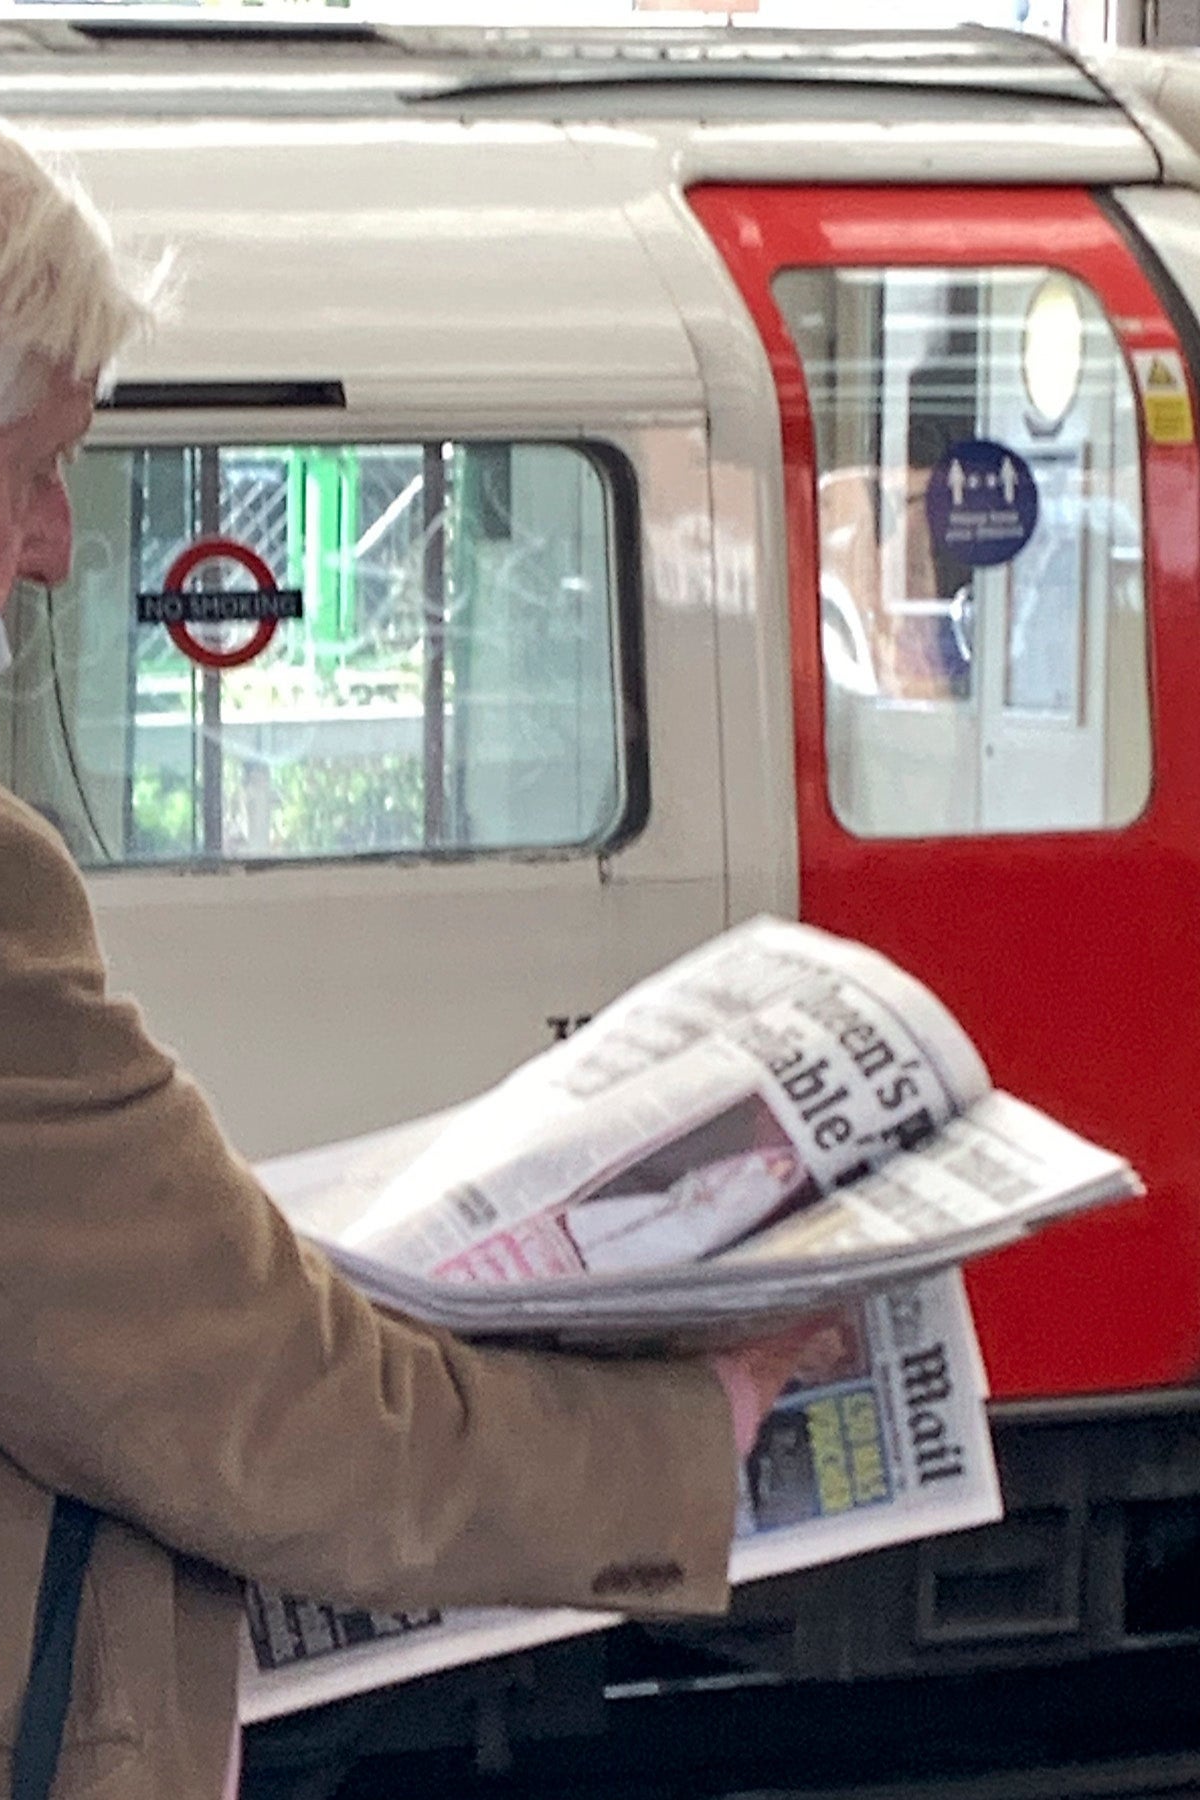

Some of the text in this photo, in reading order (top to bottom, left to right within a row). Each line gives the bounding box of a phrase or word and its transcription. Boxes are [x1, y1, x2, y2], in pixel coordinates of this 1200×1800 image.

[146, 596, 296, 620] NO SMOKING
[903, 1342, 964, 1484] Mail
